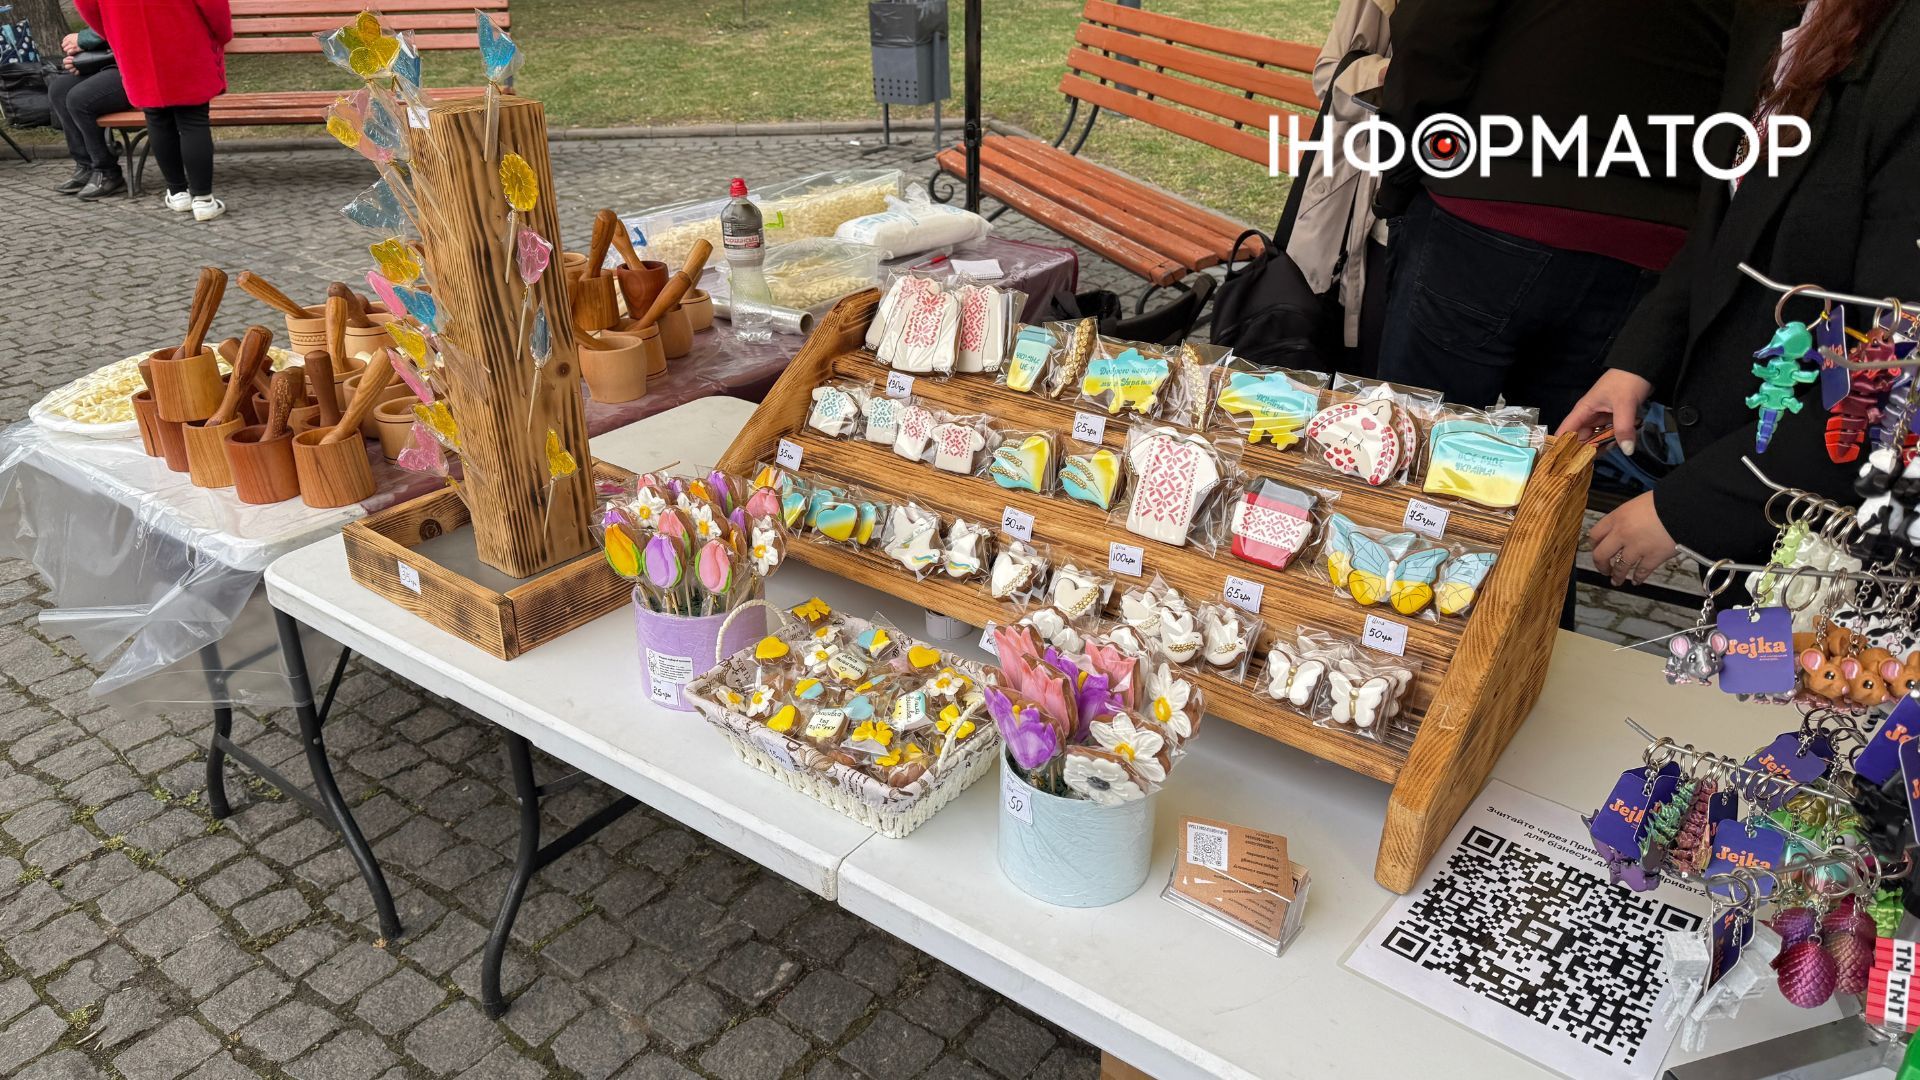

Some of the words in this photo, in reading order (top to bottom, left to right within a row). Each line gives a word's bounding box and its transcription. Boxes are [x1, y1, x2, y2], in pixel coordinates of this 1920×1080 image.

[1725, 636, 1787, 659] Jejka
[1486, 806, 1535, 829] Зчитайте
[1537, 827, 1567, 843] через
[1523, 832, 1545, 842] для
[1594, 860, 1611, 869] дл
[1659, 874, 1706, 897] Приват2
[1896, 946, 1912, 974] TN
[1888, 978, 1907, 1018] TNT
